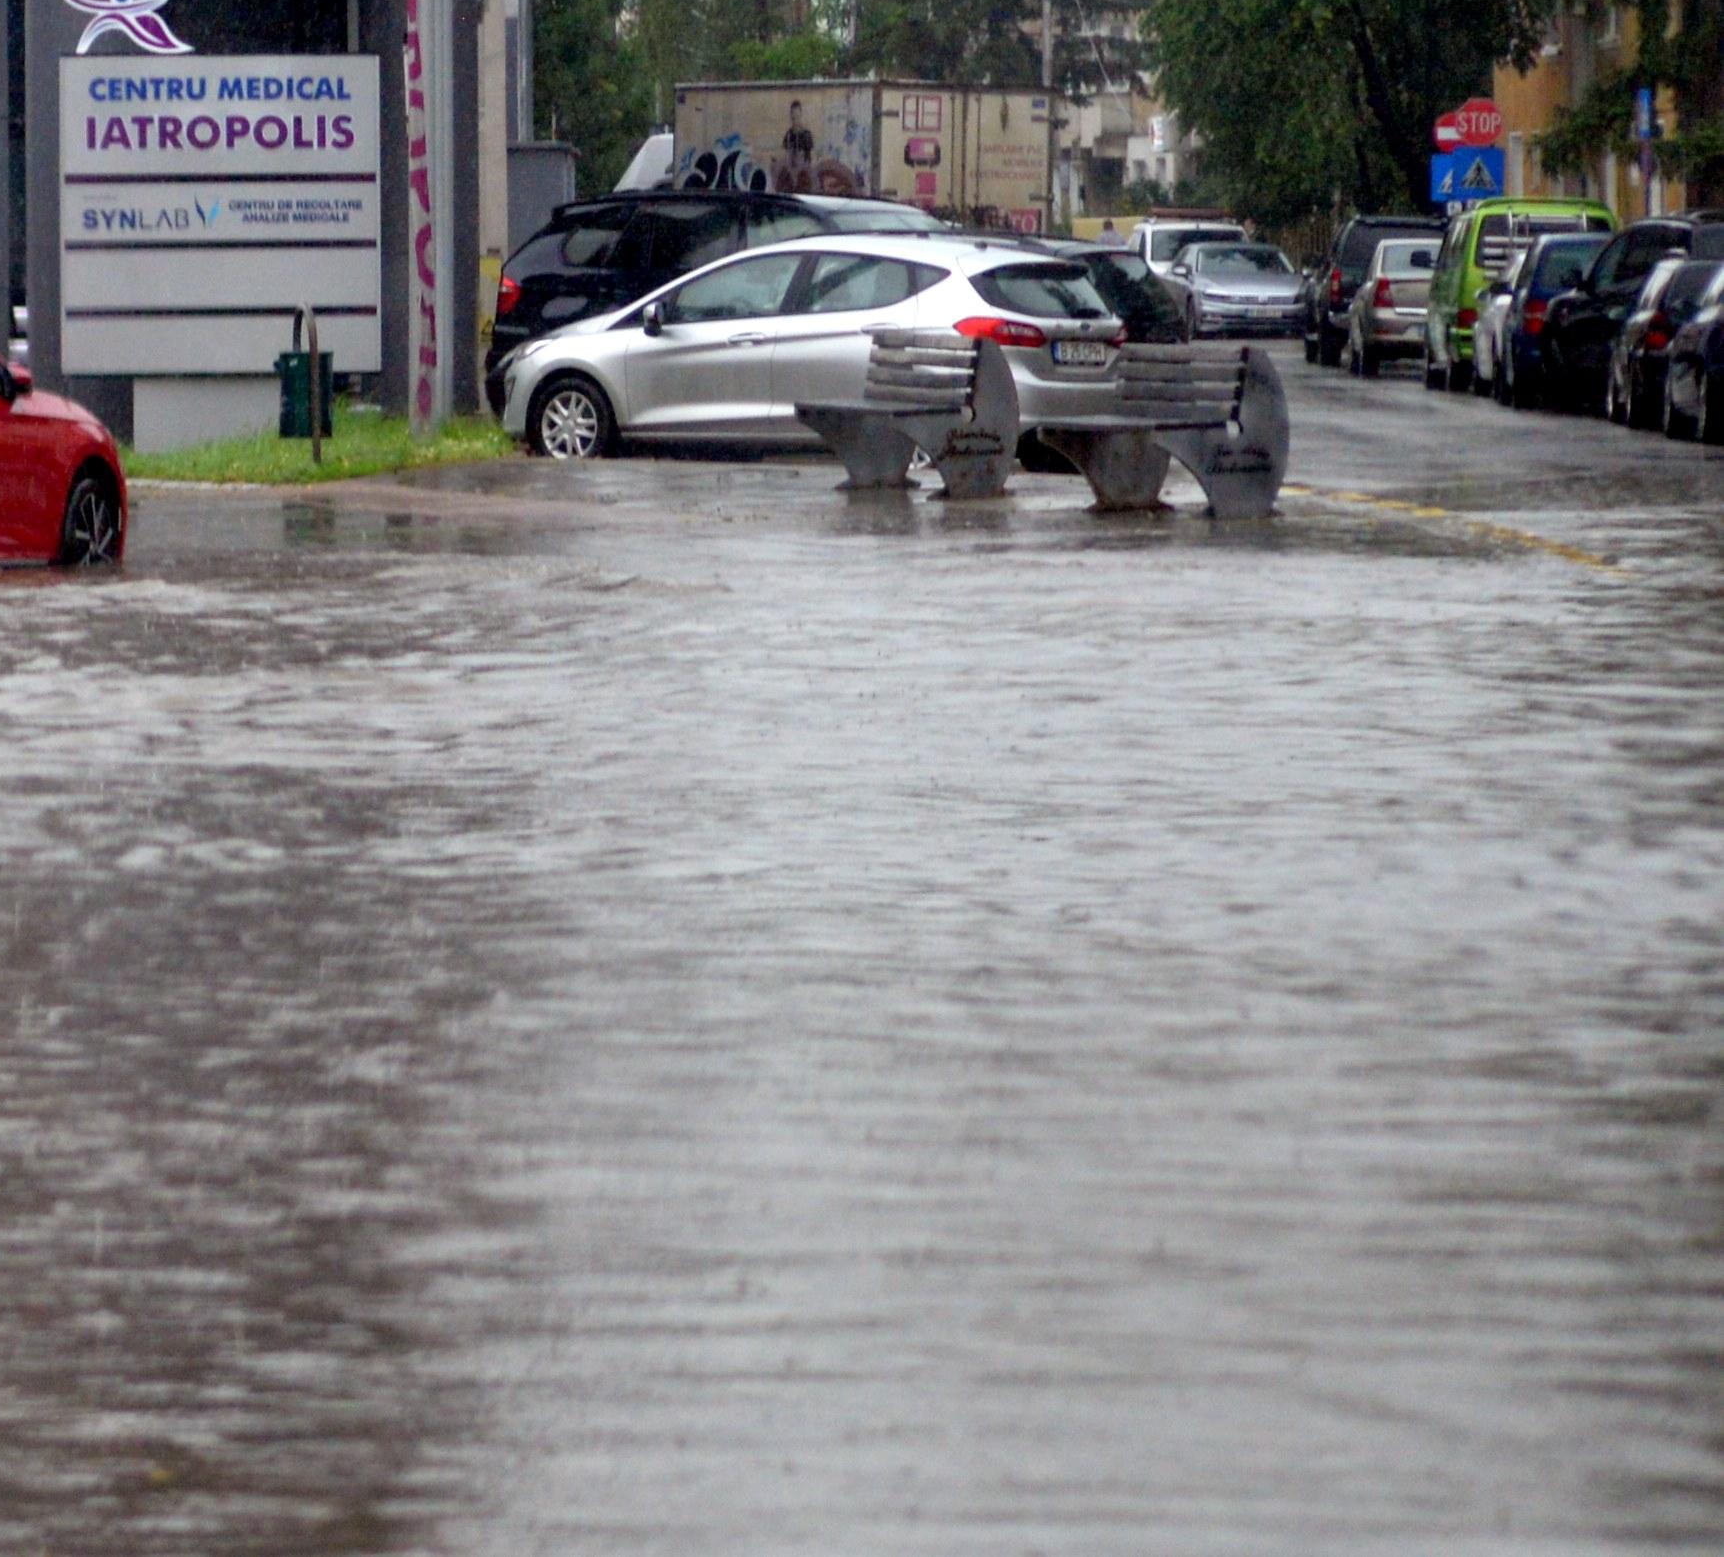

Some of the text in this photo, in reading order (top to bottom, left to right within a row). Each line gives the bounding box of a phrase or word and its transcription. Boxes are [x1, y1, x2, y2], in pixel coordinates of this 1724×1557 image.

[89, 77, 351, 102] CENTRU MEDICAL
[86, 114, 355, 150] IATROPOLIS
[1459, 112, 1501, 133] STOP
[228, 199, 363, 210] CENTRU DE RECOLTARE
[83, 208, 190, 230] SYNLAB
[242, 212, 350, 223] ANALIZE MEDICALE
